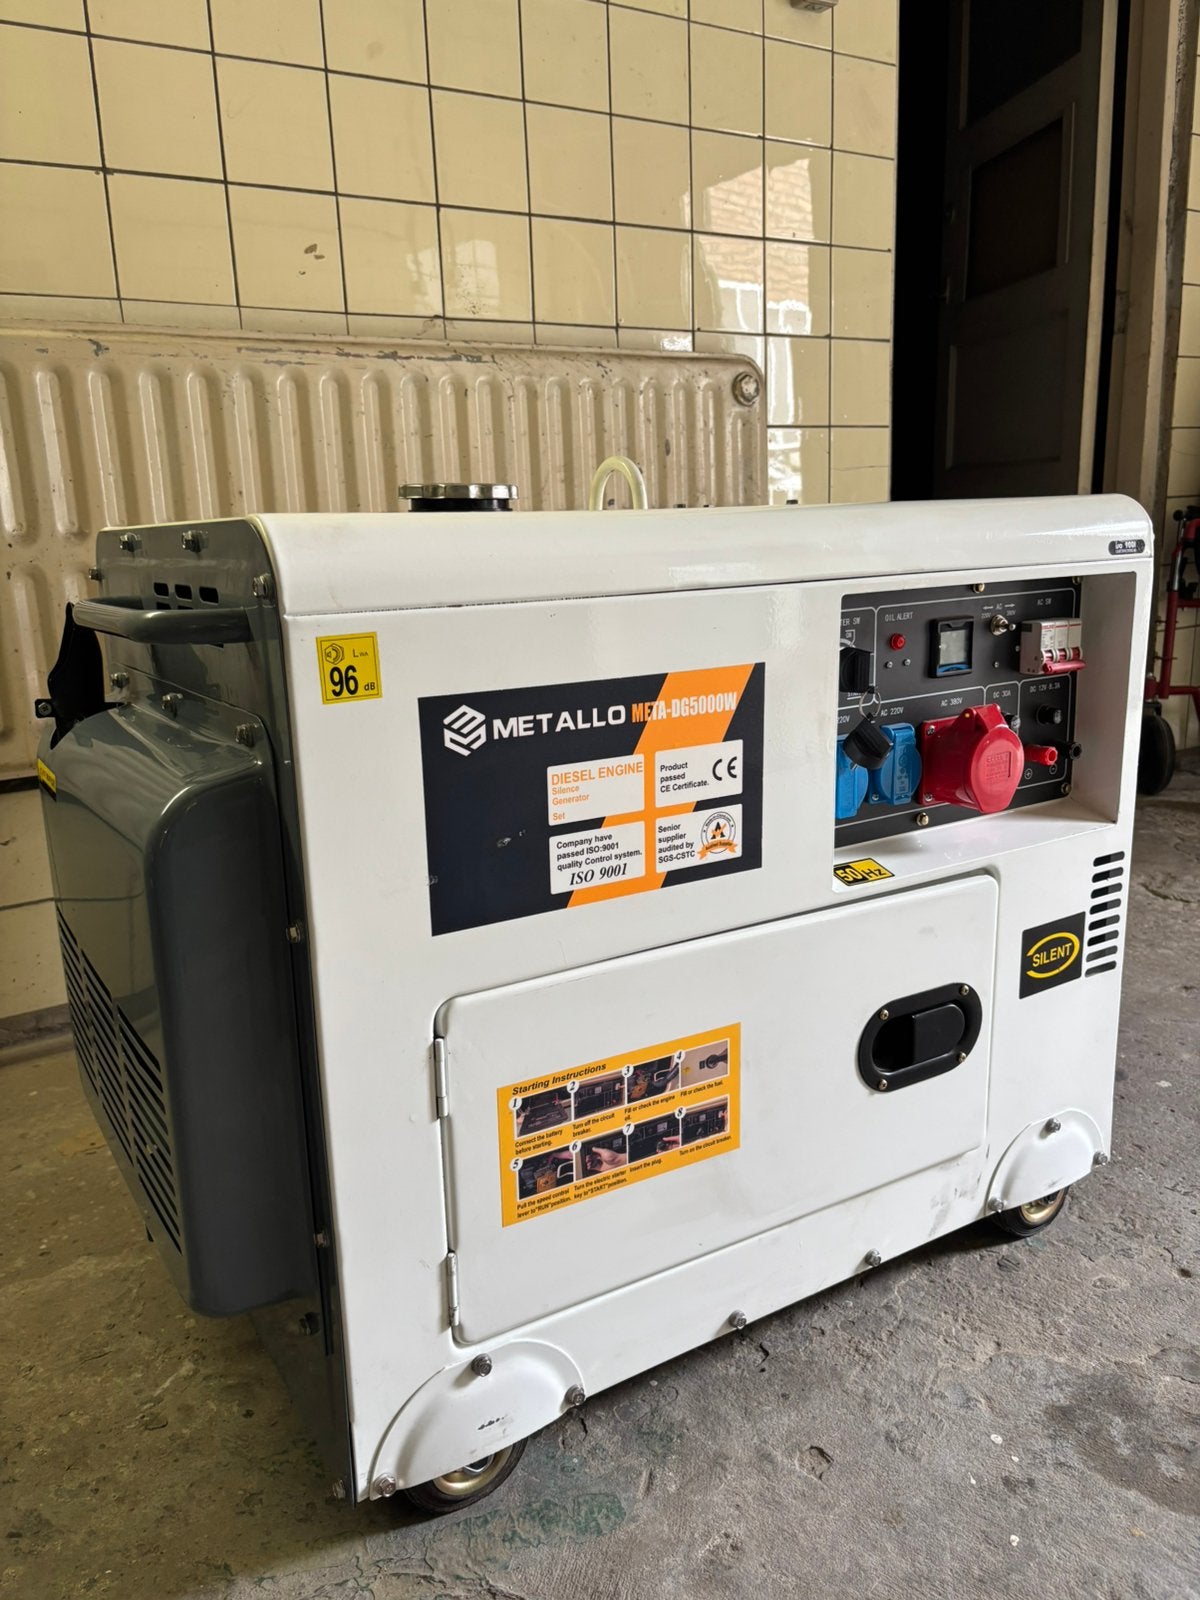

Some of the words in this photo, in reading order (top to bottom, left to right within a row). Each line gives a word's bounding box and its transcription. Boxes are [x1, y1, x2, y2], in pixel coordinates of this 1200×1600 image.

[884, 614, 895, 622] OIL
[896, 611, 914, 621] ALERT
[329, 664, 359, 697] 96
[364, 682, 376, 691] dB
[940, 699, 948, 707] AC
[492, 704, 626, 740] METALLO
[631, 692, 738, 724] META-DG5000W
[880, 708, 888, 717] AC
[890, 706, 904, 715] 220V
[660, 762, 688, 772] Product
[551, 769, 595, 786] DIESEL
[598, 761, 644, 779] ENGINE
[660, 772, 686, 783] passed
[551, 784, 580, 796] Silence
[660, 785, 671, 793] CE
[672, 779, 709, 791] Certificate.
[552, 793, 590, 806] Generator
[552, 812, 566, 821] Set
[658, 823, 681, 833] Senior
[556, 836, 592, 850] Company
[594, 833, 613, 842] have
[658, 832, 687, 843] supplier
[556, 847, 585, 862] passed
[586, 842, 619, 855] ISO:9001
[658, 842, 684, 853] audited
[685, 841, 694, 849] by
[557, 859, 583, 871] quality
[584, 854, 613, 866] Control
[614, 848, 643, 861] system.
[658, 850, 696, 864] SGS-CSTC
[569, 870, 595, 886] ISO
[599, 863, 628, 880] 9001
[835, 867, 863, 882] 50
[861, 868, 887, 879] Hz
[1032, 942, 1073, 967] SILENT
[676, 1051, 683, 1060] 4
[624, 1066, 631, 1076] 3
[512, 1079, 550, 1096] Starting
[552, 1063, 607, 1085] Instructions
[569, 1081, 576, 1091] 2
[693, 1085, 707, 1094] check
[513, 1098, 518, 1108] 1
[624, 1106, 632, 1114] Fill
[638, 1100, 652, 1110] check
[660, 1094, 675, 1105] engine
[677, 1107, 683, 1117] 8
[572, 1122, 584, 1130] Turn
[600, 1113, 615, 1122] circuit
[625, 1123, 632, 1133] 7
[514, 1136, 537, 1148] Connect
[545, 1129, 563, 1140] battery
[572, 1142, 578, 1151] 6
[703, 1140, 716, 1149] circuit
[515, 1146, 532, 1155] before
[513, 1159, 520, 1169] 5
[630, 1164, 643, 1173] Insert
[574, 1183, 585, 1191] Turn
[594, 1174, 611, 1185] electric
[612, 1170, 627, 1180] starter
[517, 1202, 527, 1211] Pull
[527, 1199, 536, 1208] the
[537, 1194, 552, 1206] speed
[552, 1188, 570, 1199] control
[574, 1192, 583, 1200] key
[517, 1209, 530, 1219] lever
